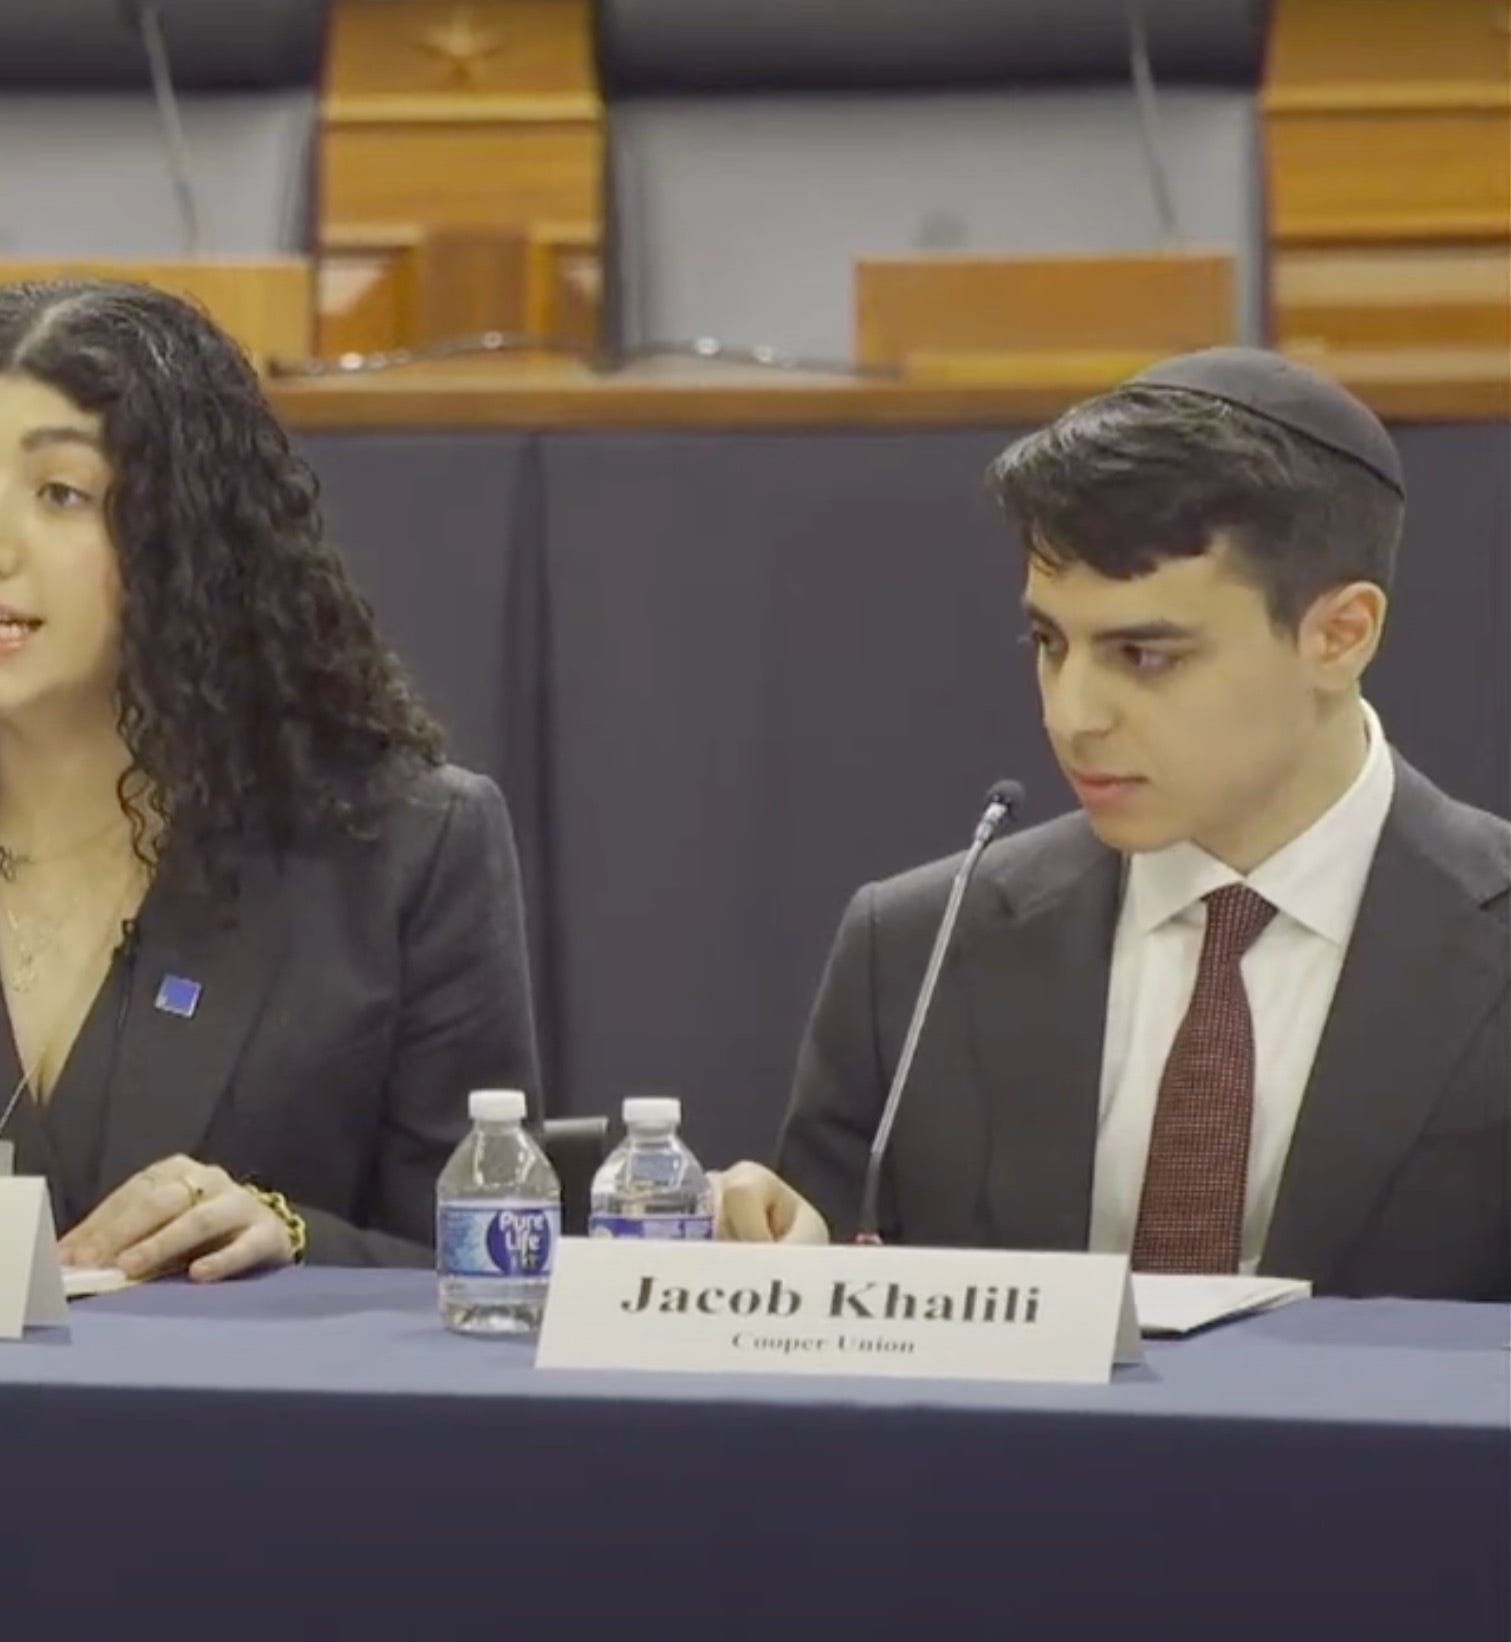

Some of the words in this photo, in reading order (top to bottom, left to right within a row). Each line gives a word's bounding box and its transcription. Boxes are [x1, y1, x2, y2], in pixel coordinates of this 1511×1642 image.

[498, 1210, 544, 1233] Pure
[619, 1275, 803, 1316] Jacob
[828, 1280, 1040, 1324] Khalili
[731, 1332, 827, 1355] Cooper
[837, 1334, 916, 1353] Union
